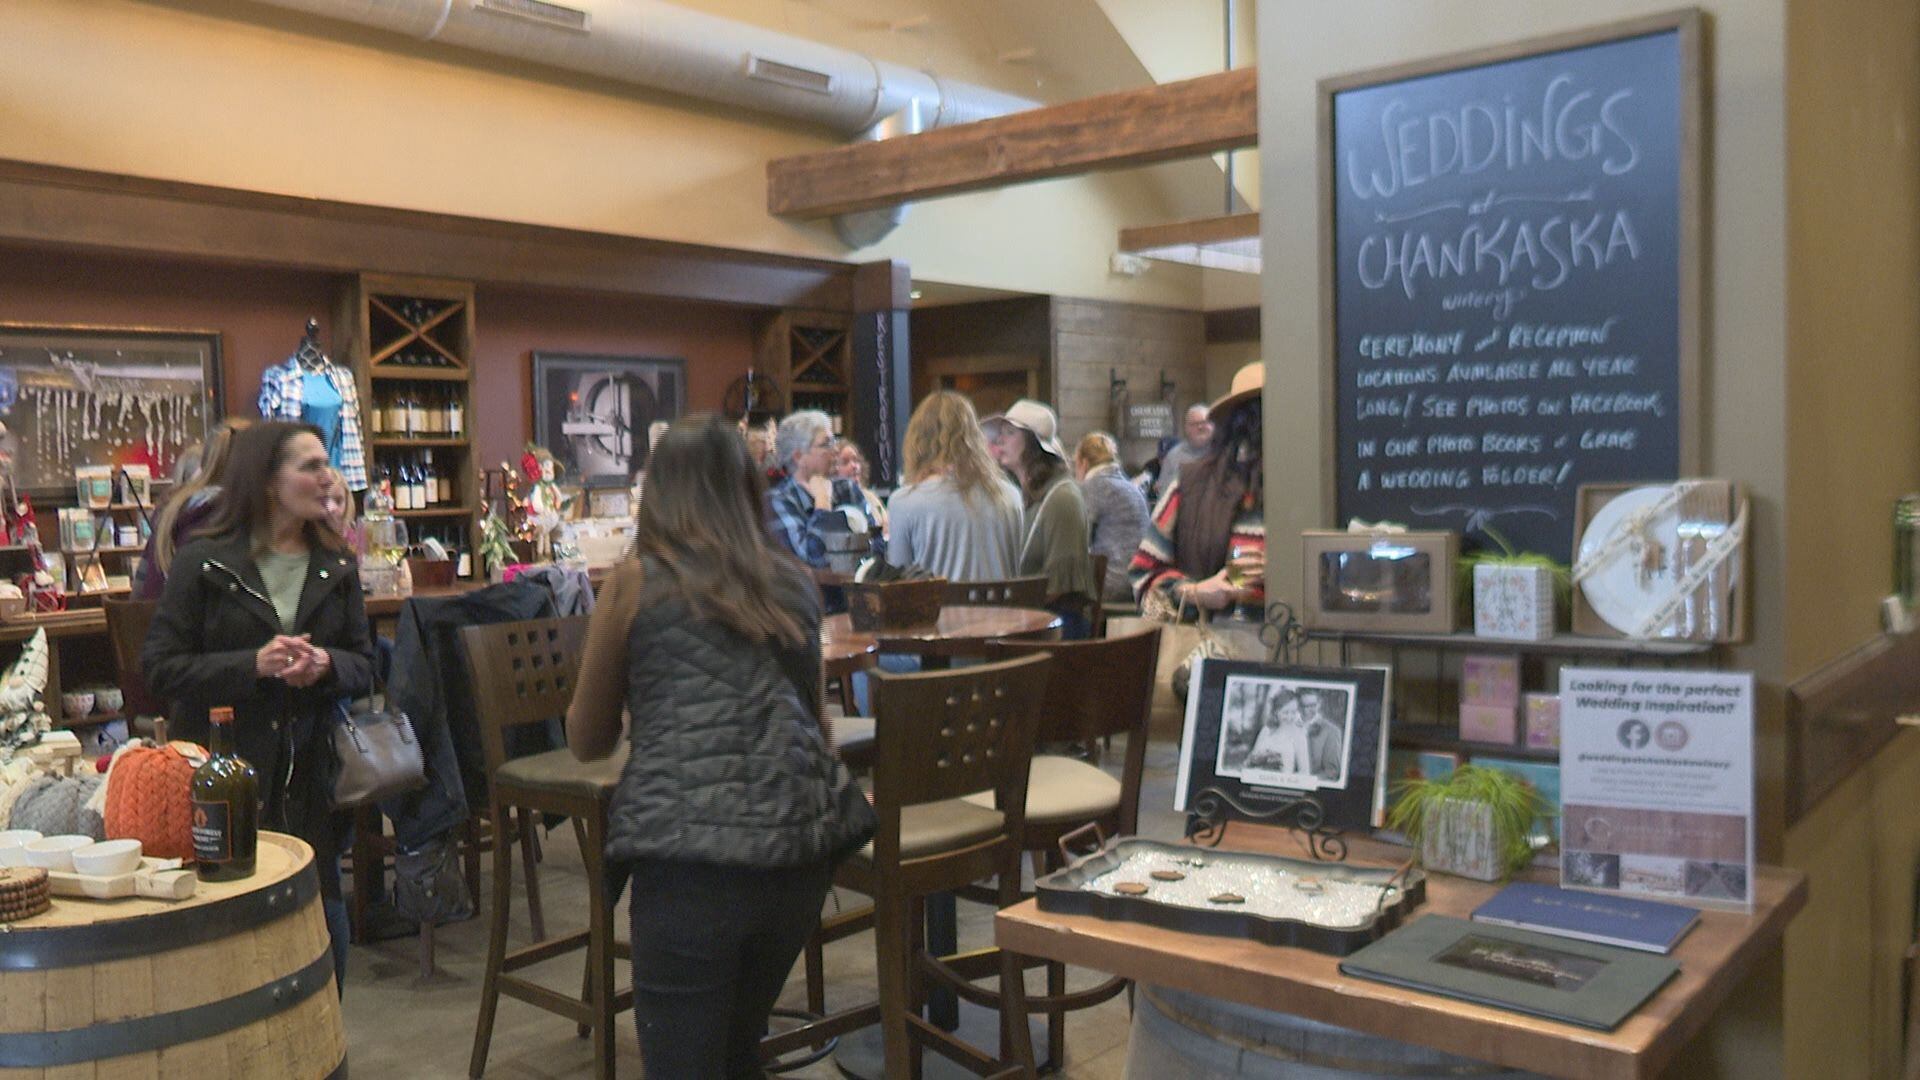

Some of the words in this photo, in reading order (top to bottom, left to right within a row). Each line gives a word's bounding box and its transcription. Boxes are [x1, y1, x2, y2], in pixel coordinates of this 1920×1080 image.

[1348, 73, 1640, 199] WEDDINGS
[1358, 211, 1638, 299] CHANKASKA
[1359, 330, 1463, 358] CEREMONY
[1508, 318, 1617, 349] RECEPTION
[1357, 367, 1437, 388] LOCATIONS
[1446, 361, 1539, 383] AVAILABLE
[1548, 357, 1575, 378] ALL
[1583, 354, 1639, 377] YEAR
[876, 312, 891, 481] RESTROOMS
[1422, 394, 1457, 418] SEE
[1466, 397, 1528, 418] PHOTOS
[1537, 400, 1561, 416] ON
[1358, 440, 1376, 458] IN
[1385, 438, 1417, 457] OUR
[1427, 434, 1473, 454] PHOTO
[1482, 432, 1542, 453] BOOKS
[1580, 428, 1637, 450] GRAB
[1358, 470, 1371, 490] A
[1381, 468, 1470, 489] WEDDING
[1482, 458, 1575, 490] FOLDER!
[1570, 679, 1627, 694] Looking
[1632, 681, 1652, 694] for
[1657, 682, 1680, 695] the
[1684, 684, 1741, 698] perfect
[1576, 697, 1641, 713] Wedding
